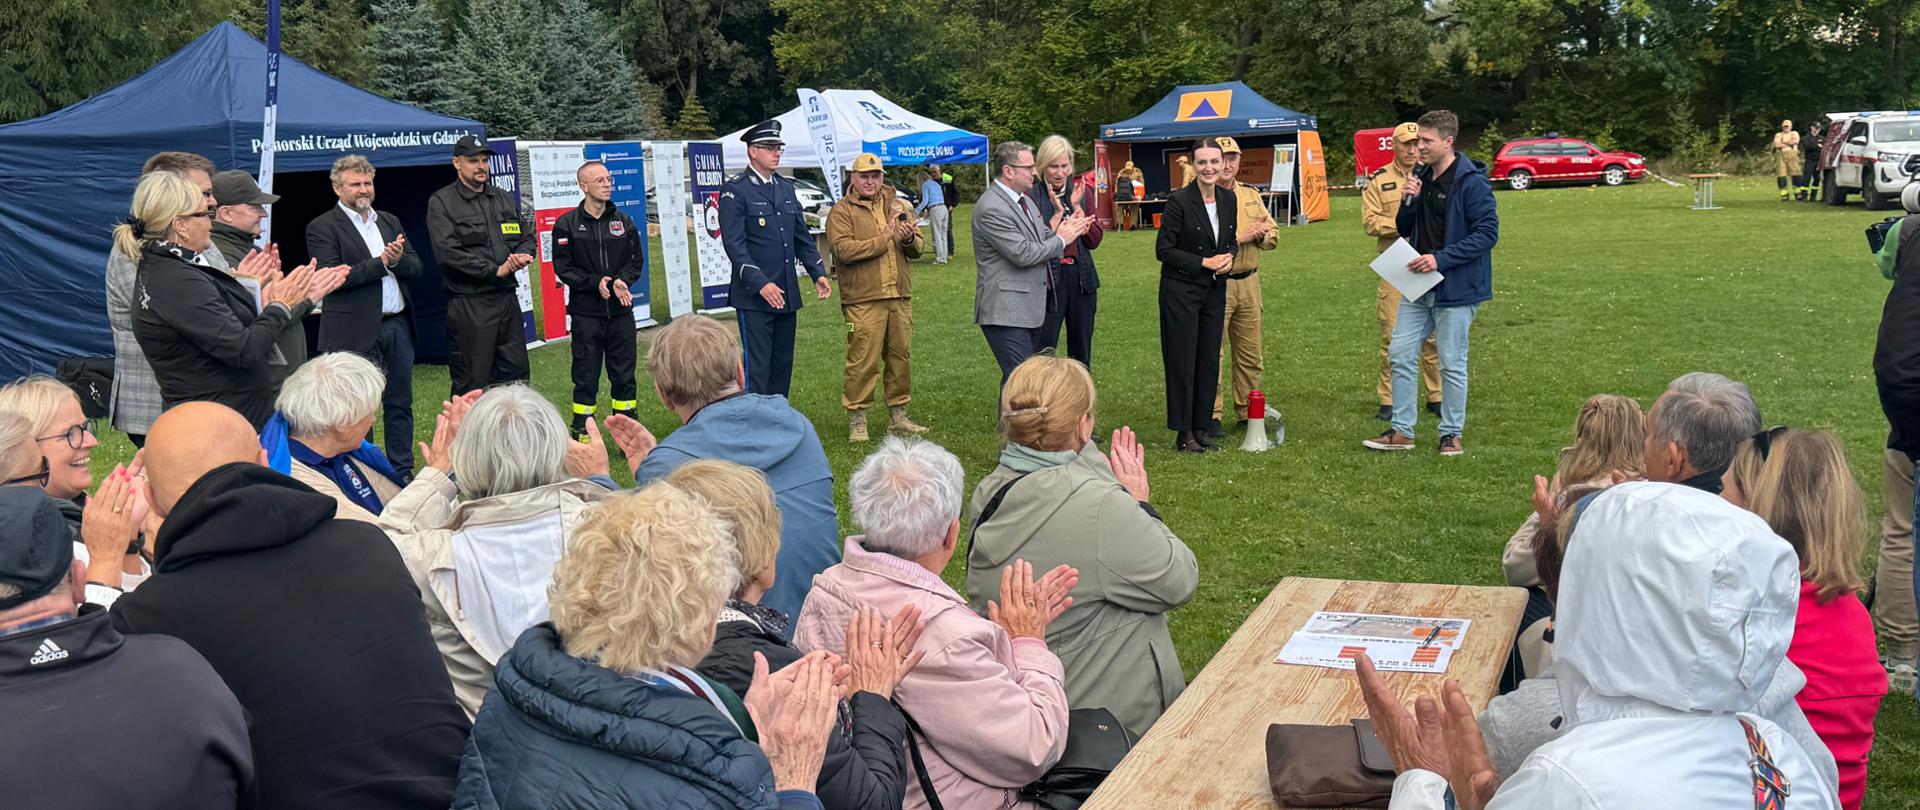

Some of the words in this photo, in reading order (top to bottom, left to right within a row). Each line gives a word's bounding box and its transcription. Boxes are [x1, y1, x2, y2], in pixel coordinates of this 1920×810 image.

[316, 133, 353, 152] Urząd
[353, 131, 421, 151] Wojewódzki
[421, 135, 432, 145] w
[432, 129, 479, 145] Gdań
[488, 154, 514, 174] MINA
[694, 154, 721, 171] GMINA
[491, 174, 516, 192] BUDY
[696, 171, 723, 187] KOLBUDY
[30, 649, 69, 665] adidas
